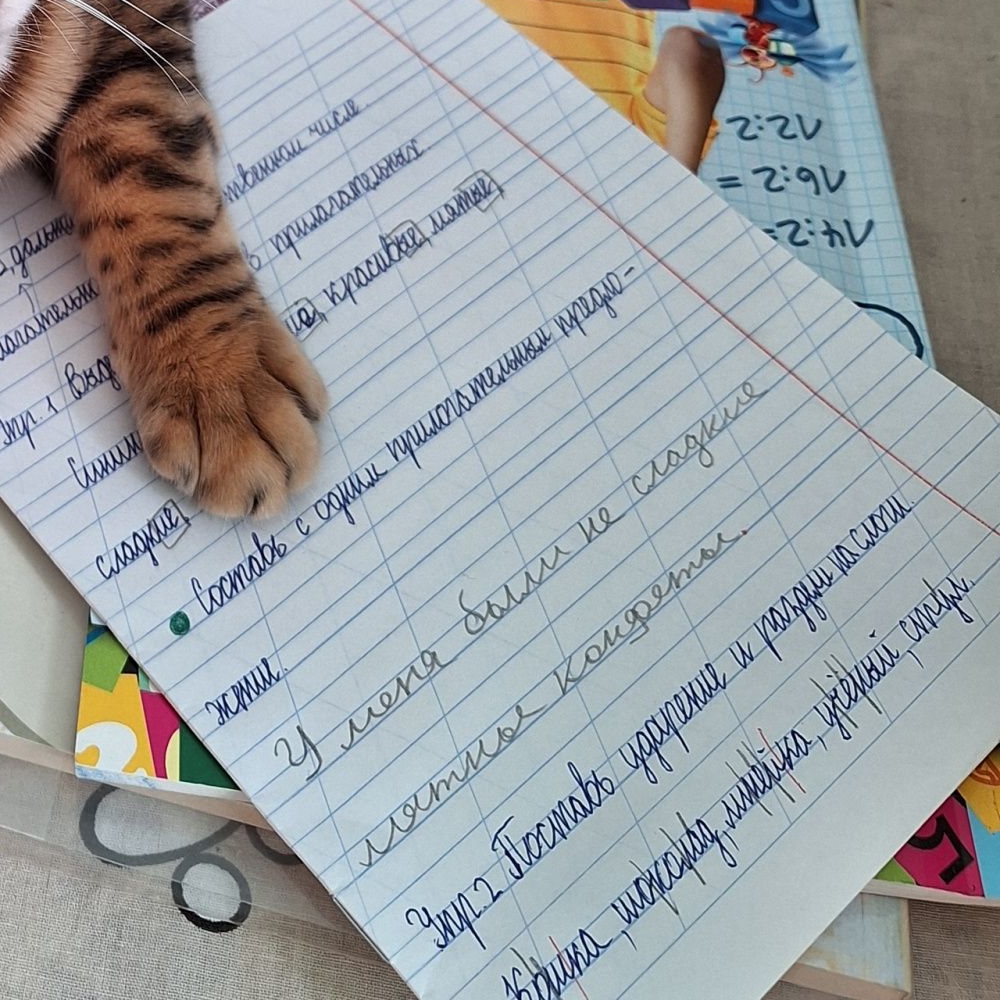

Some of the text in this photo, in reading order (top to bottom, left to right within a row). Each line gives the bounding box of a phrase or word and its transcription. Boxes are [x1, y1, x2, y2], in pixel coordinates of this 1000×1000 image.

[191, 531, 287, 615] Составь
[295, 517, 310, 536] с
[314, 462, 388, 526] одним
[274, 381, 770, 783] У меня были не сладкие
[491, 761, 615, 880] Поставь
[618, 662, 727, 785] ударение
[728, 640, 755, 670] и
[754, 567, 834, 662] раздели
